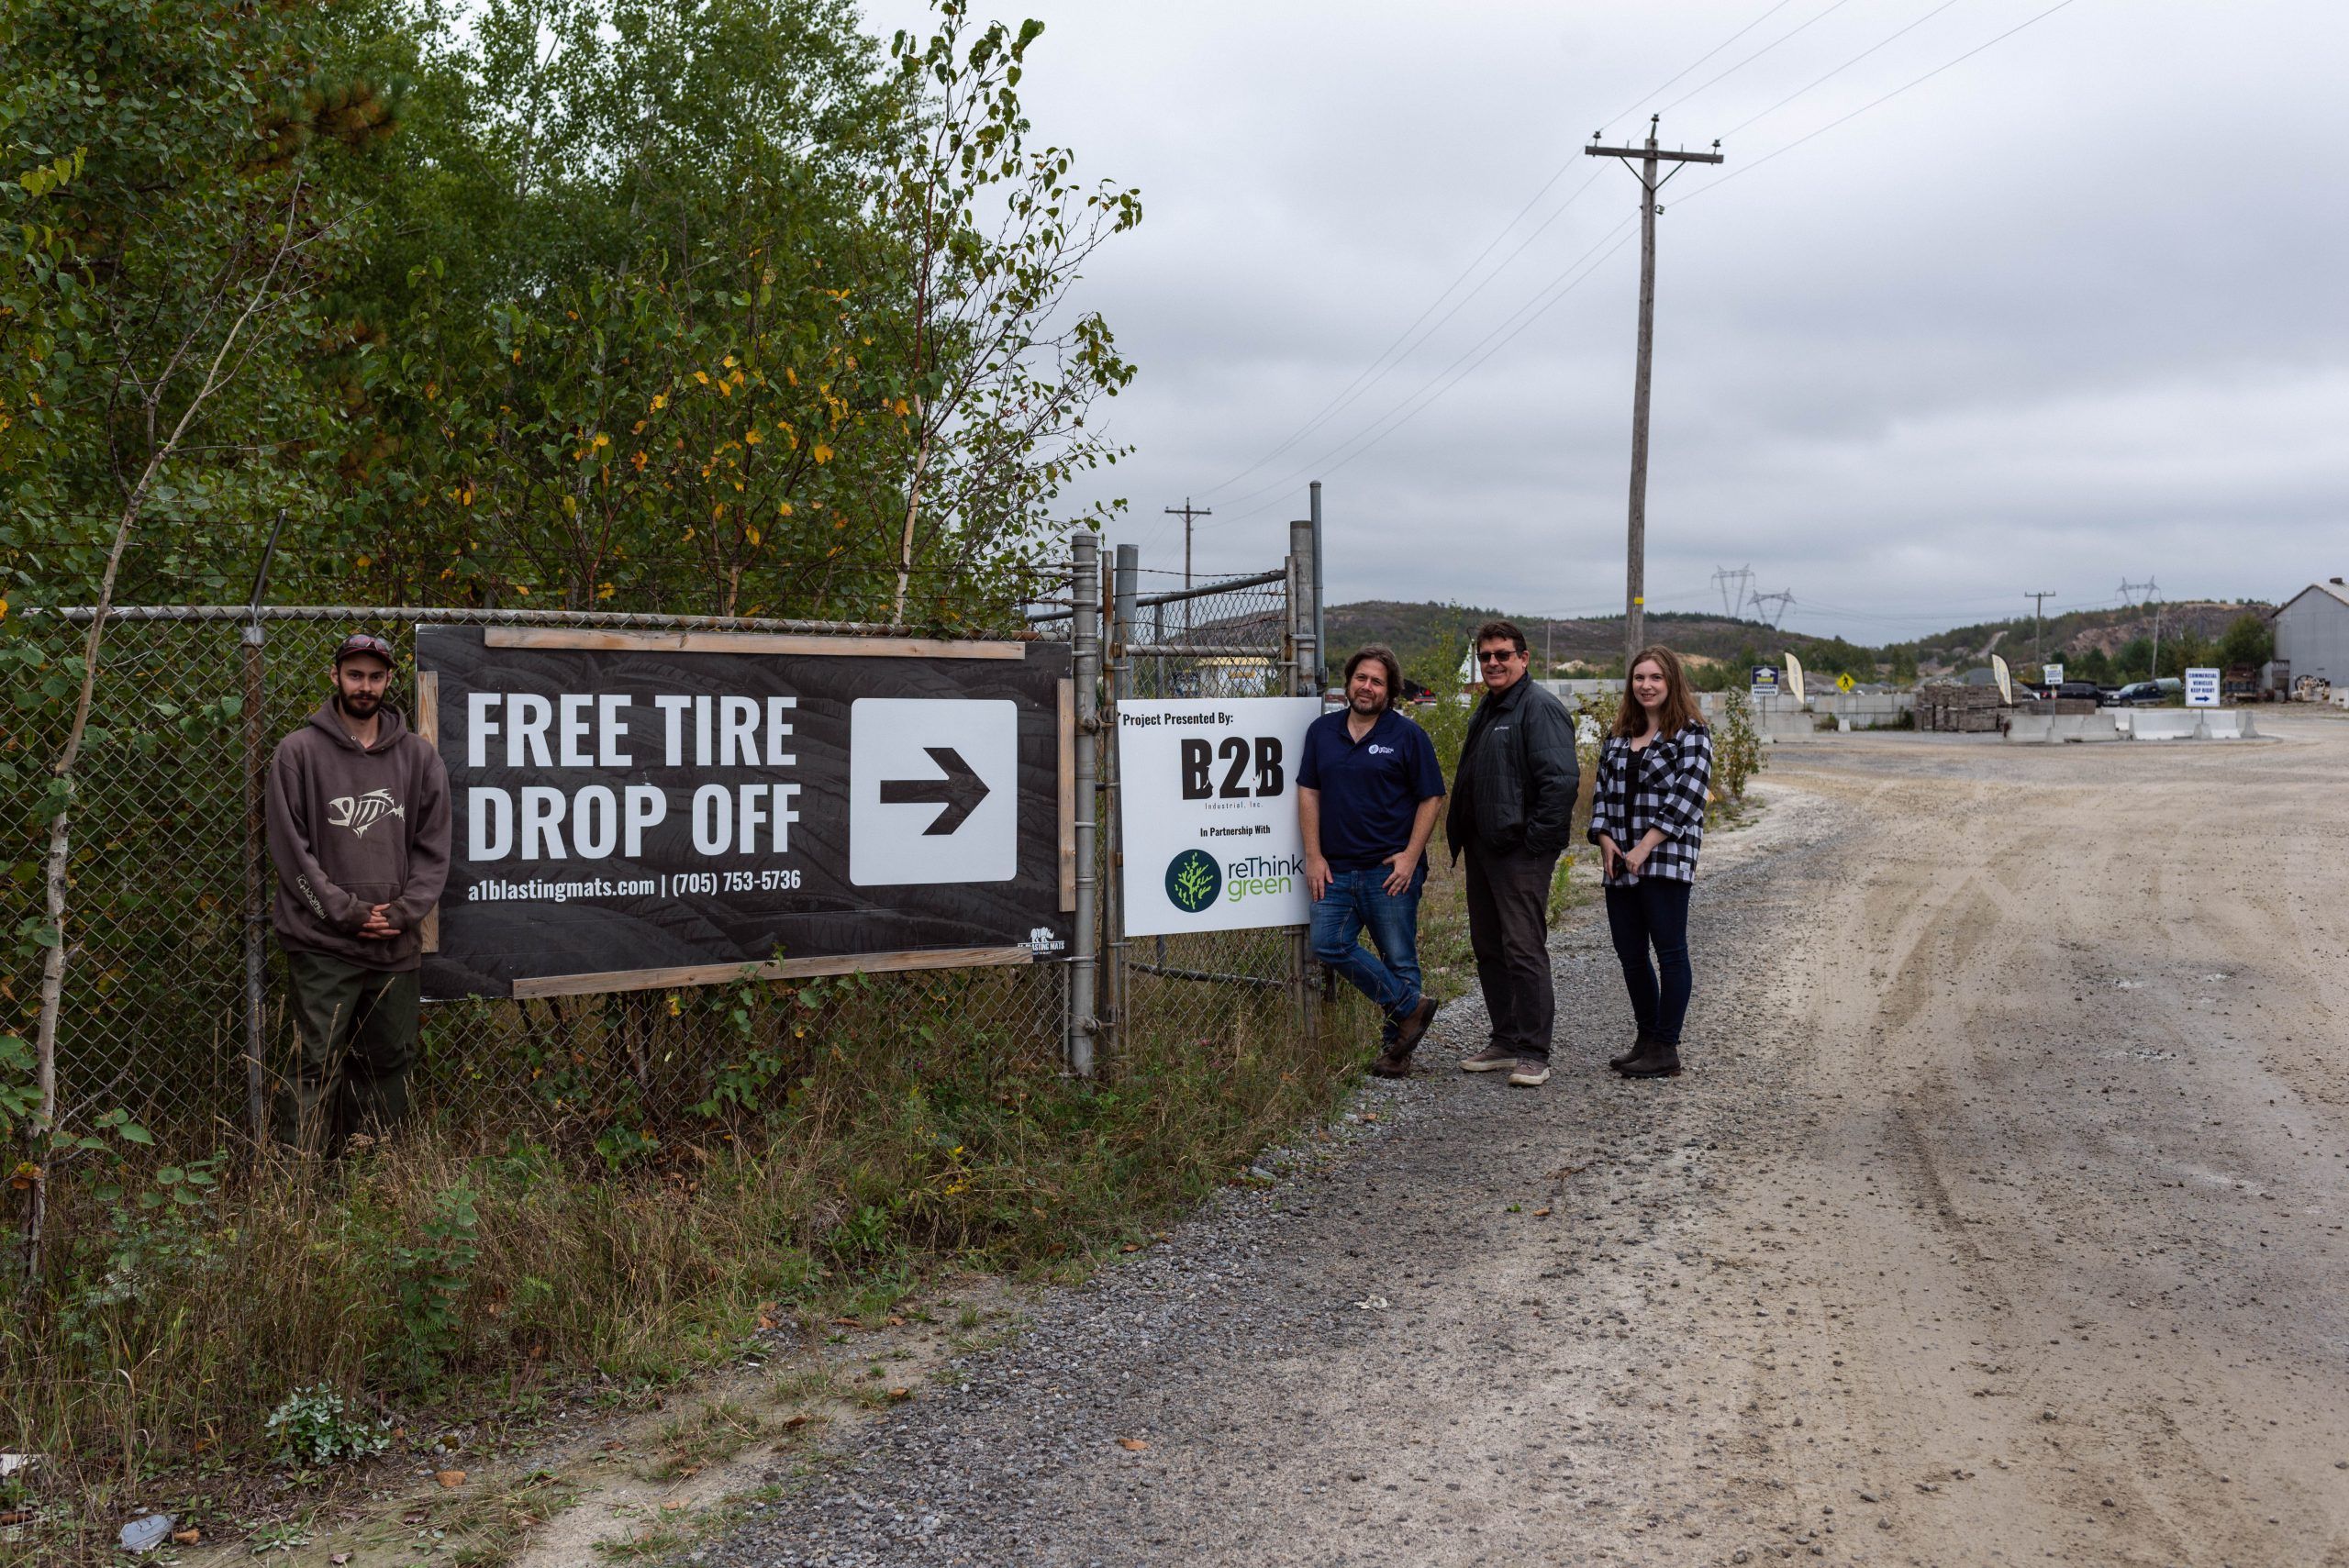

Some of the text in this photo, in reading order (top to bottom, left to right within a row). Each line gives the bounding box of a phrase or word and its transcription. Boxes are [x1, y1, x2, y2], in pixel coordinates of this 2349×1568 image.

[467, 692, 797, 768] FREE TIRE
[1122, 712, 1234, 728] Project Presented By:
[1181, 736, 1285, 800] B2B
[468, 784, 801, 862] DROP OFF
[1200, 825, 1271, 837] In Partnership With
[1228, 853, 1305, 879] reThink
[468, 877, 655, 902] a1blastingmats.com
[673, 873, 718, 897] (705)
[723, 870, 801, 893] 753-5736
[1228, 875, 1292, 903] green
